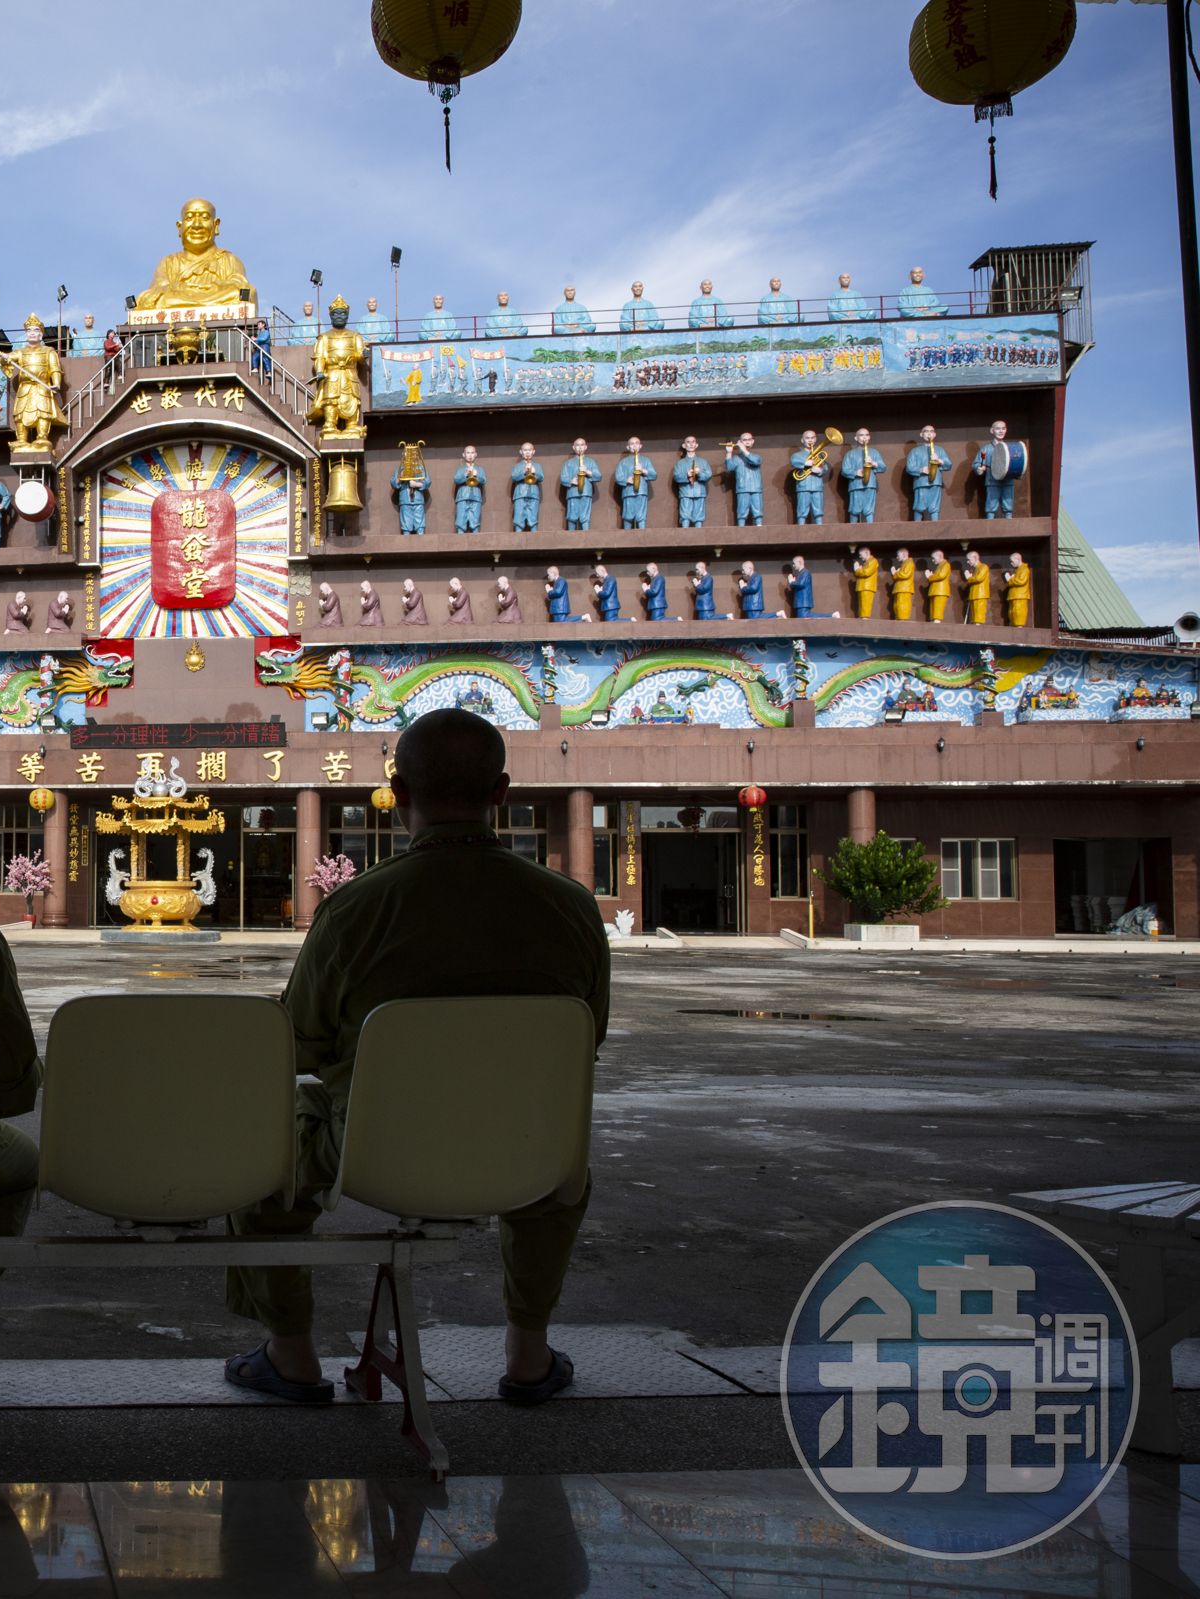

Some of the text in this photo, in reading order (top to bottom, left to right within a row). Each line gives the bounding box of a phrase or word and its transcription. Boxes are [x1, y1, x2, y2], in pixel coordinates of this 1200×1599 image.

[178, 498, 210, 599] 龍發堂
[72, 723, 281, 745] 多一分理性 少一分情緒
